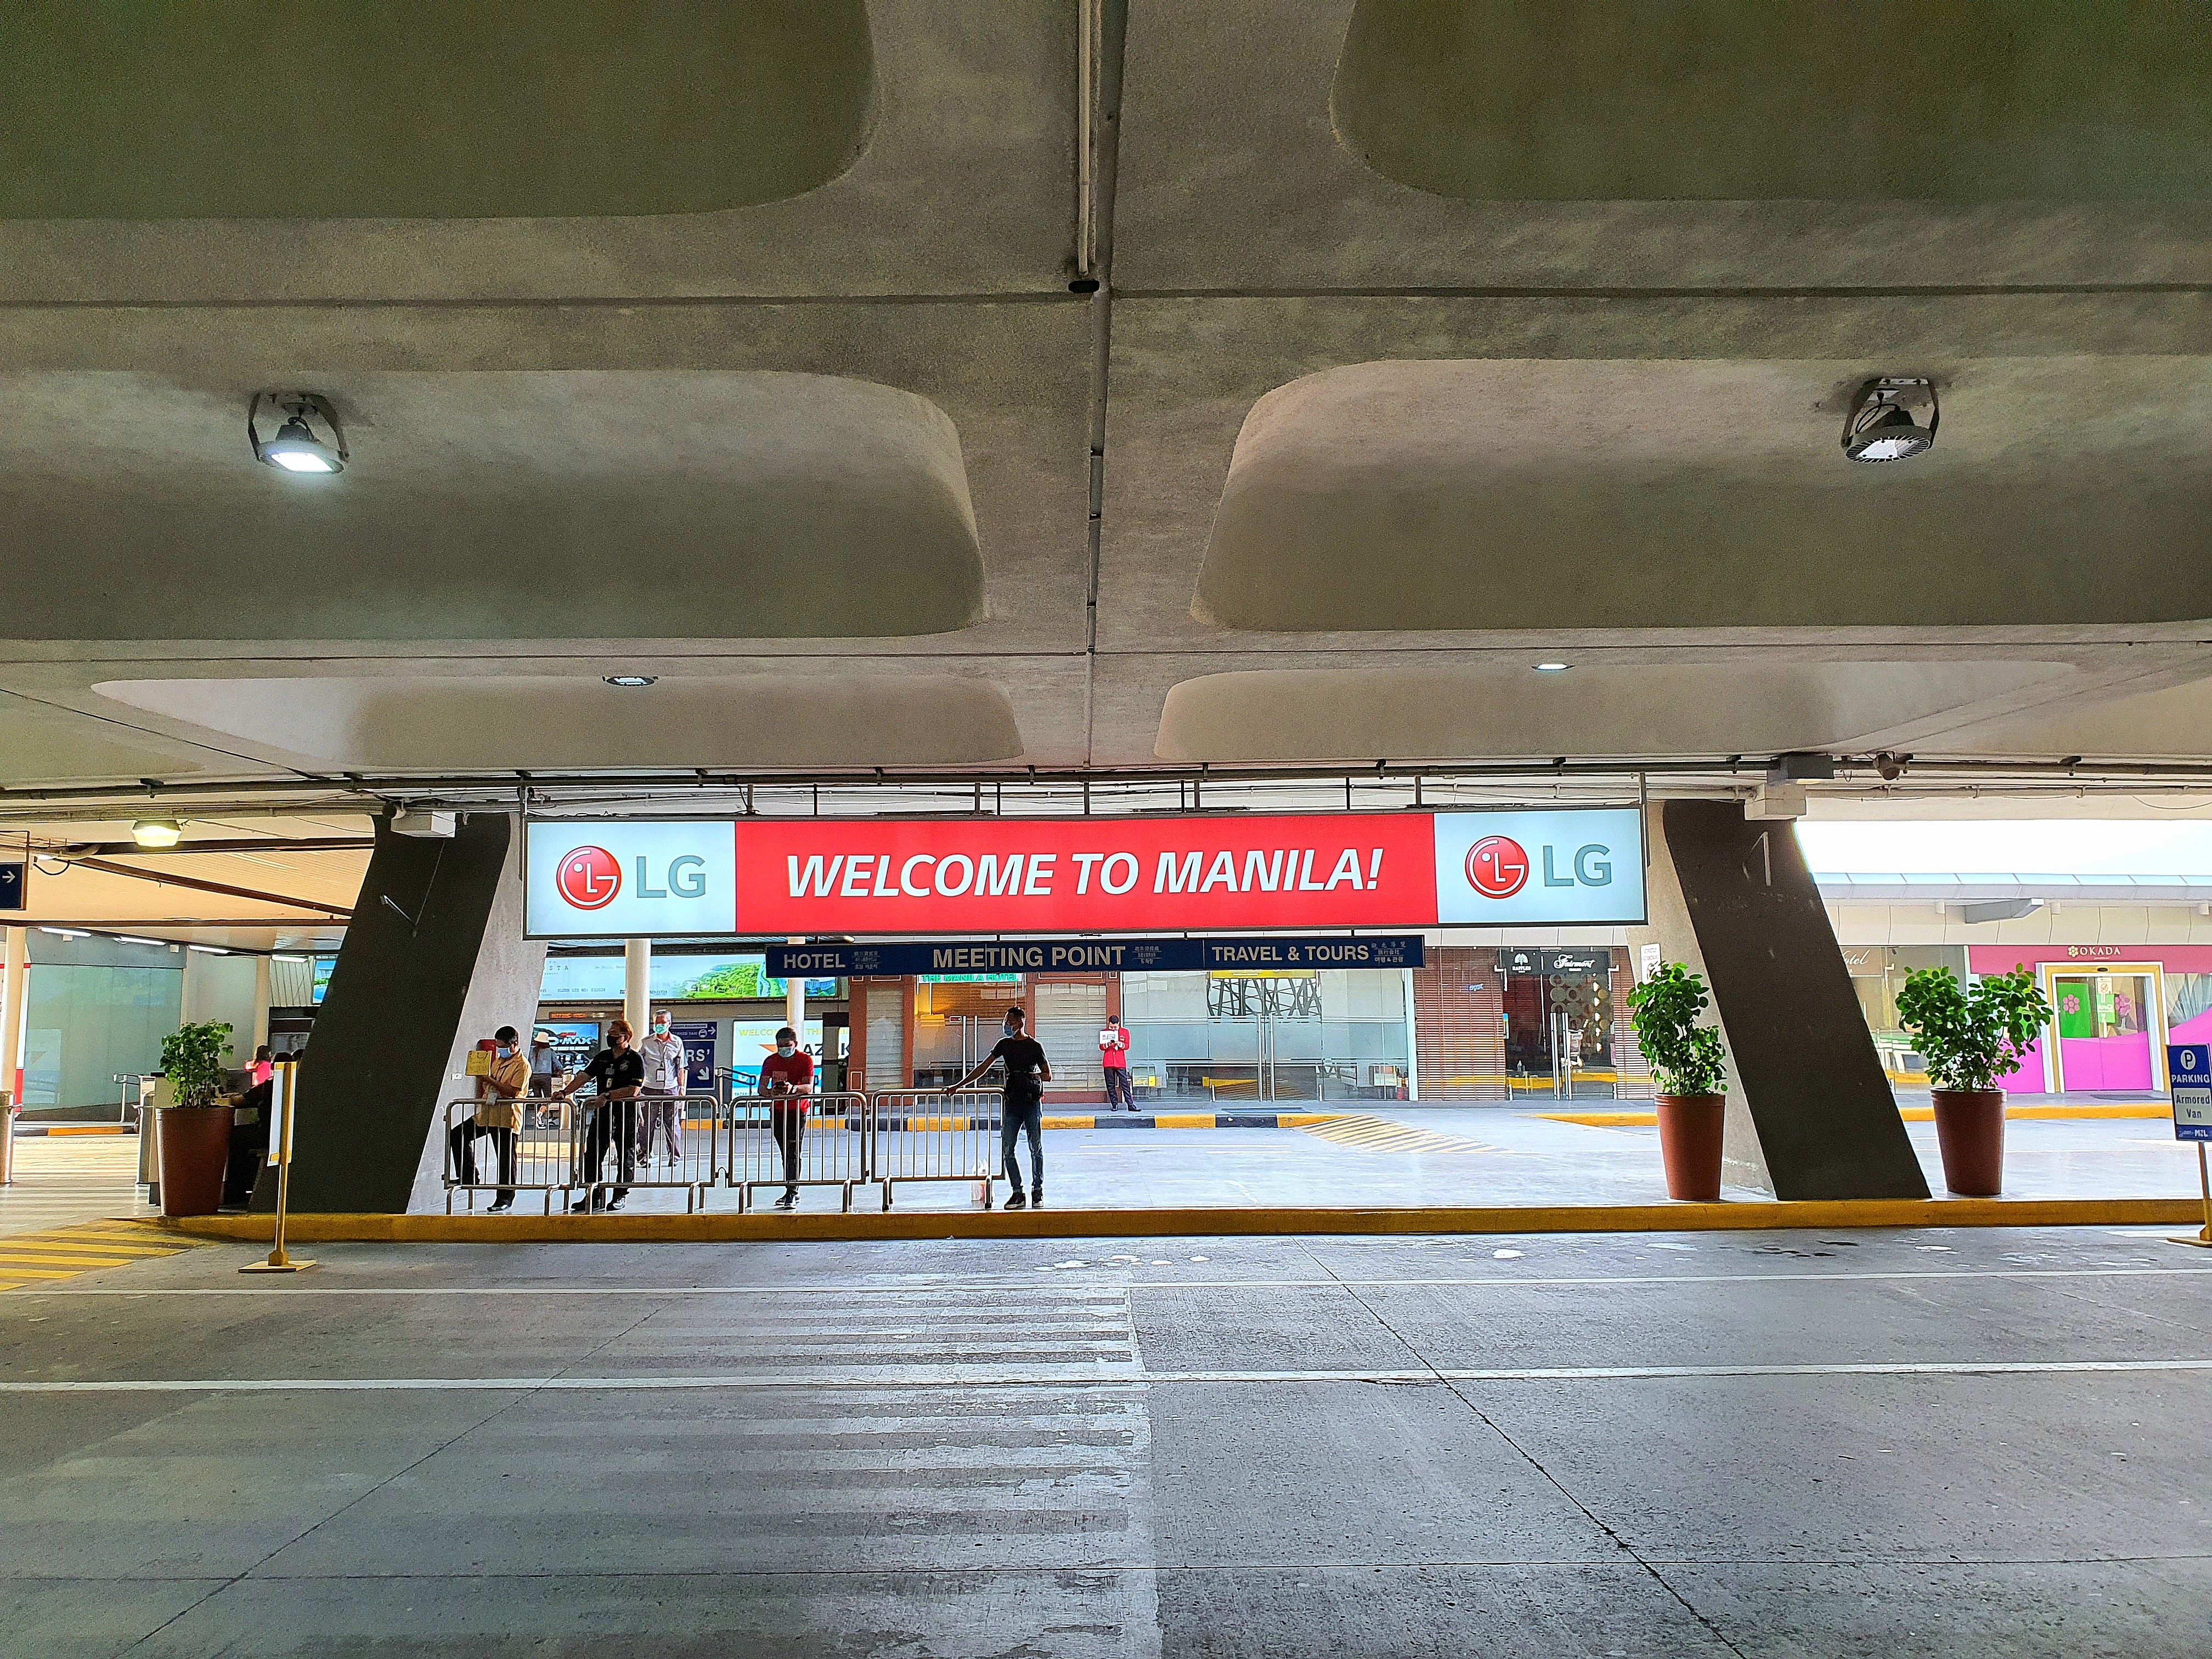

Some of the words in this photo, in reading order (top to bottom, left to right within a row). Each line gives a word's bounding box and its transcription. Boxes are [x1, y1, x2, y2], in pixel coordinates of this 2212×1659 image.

[787, 853, 1058, 898] WELCOME
[1071, 852, 1139, 895] TO
[1153, 848, 1384, 894] MANILA!
[1543, 843, 1612, 887] LG
[636, 855, 707, 899] LG
[933, 947, 1043, 968] MEETING
[1052, 946, 1126, 967] POINT
[1211, 946, 1283, 961] TRAVEL
[1288, 946, 1300, 961] &
[1305, 945, 1369, 960] TOURS
[2080, 947, 2121, 956] OKADA
[783, 953, 846, 969] HOTEL
[1553, 954, 1595, 969] Fairmont
[548, 1036, 591, 1046] D-MAX
[2184, 1052, 2193, 1068] P
[2171, 1074, 2210, 1083] PARKING
[2176, 1094, 2210, 1104] Armored
[2186, 1108, 2202, 1119] Van
